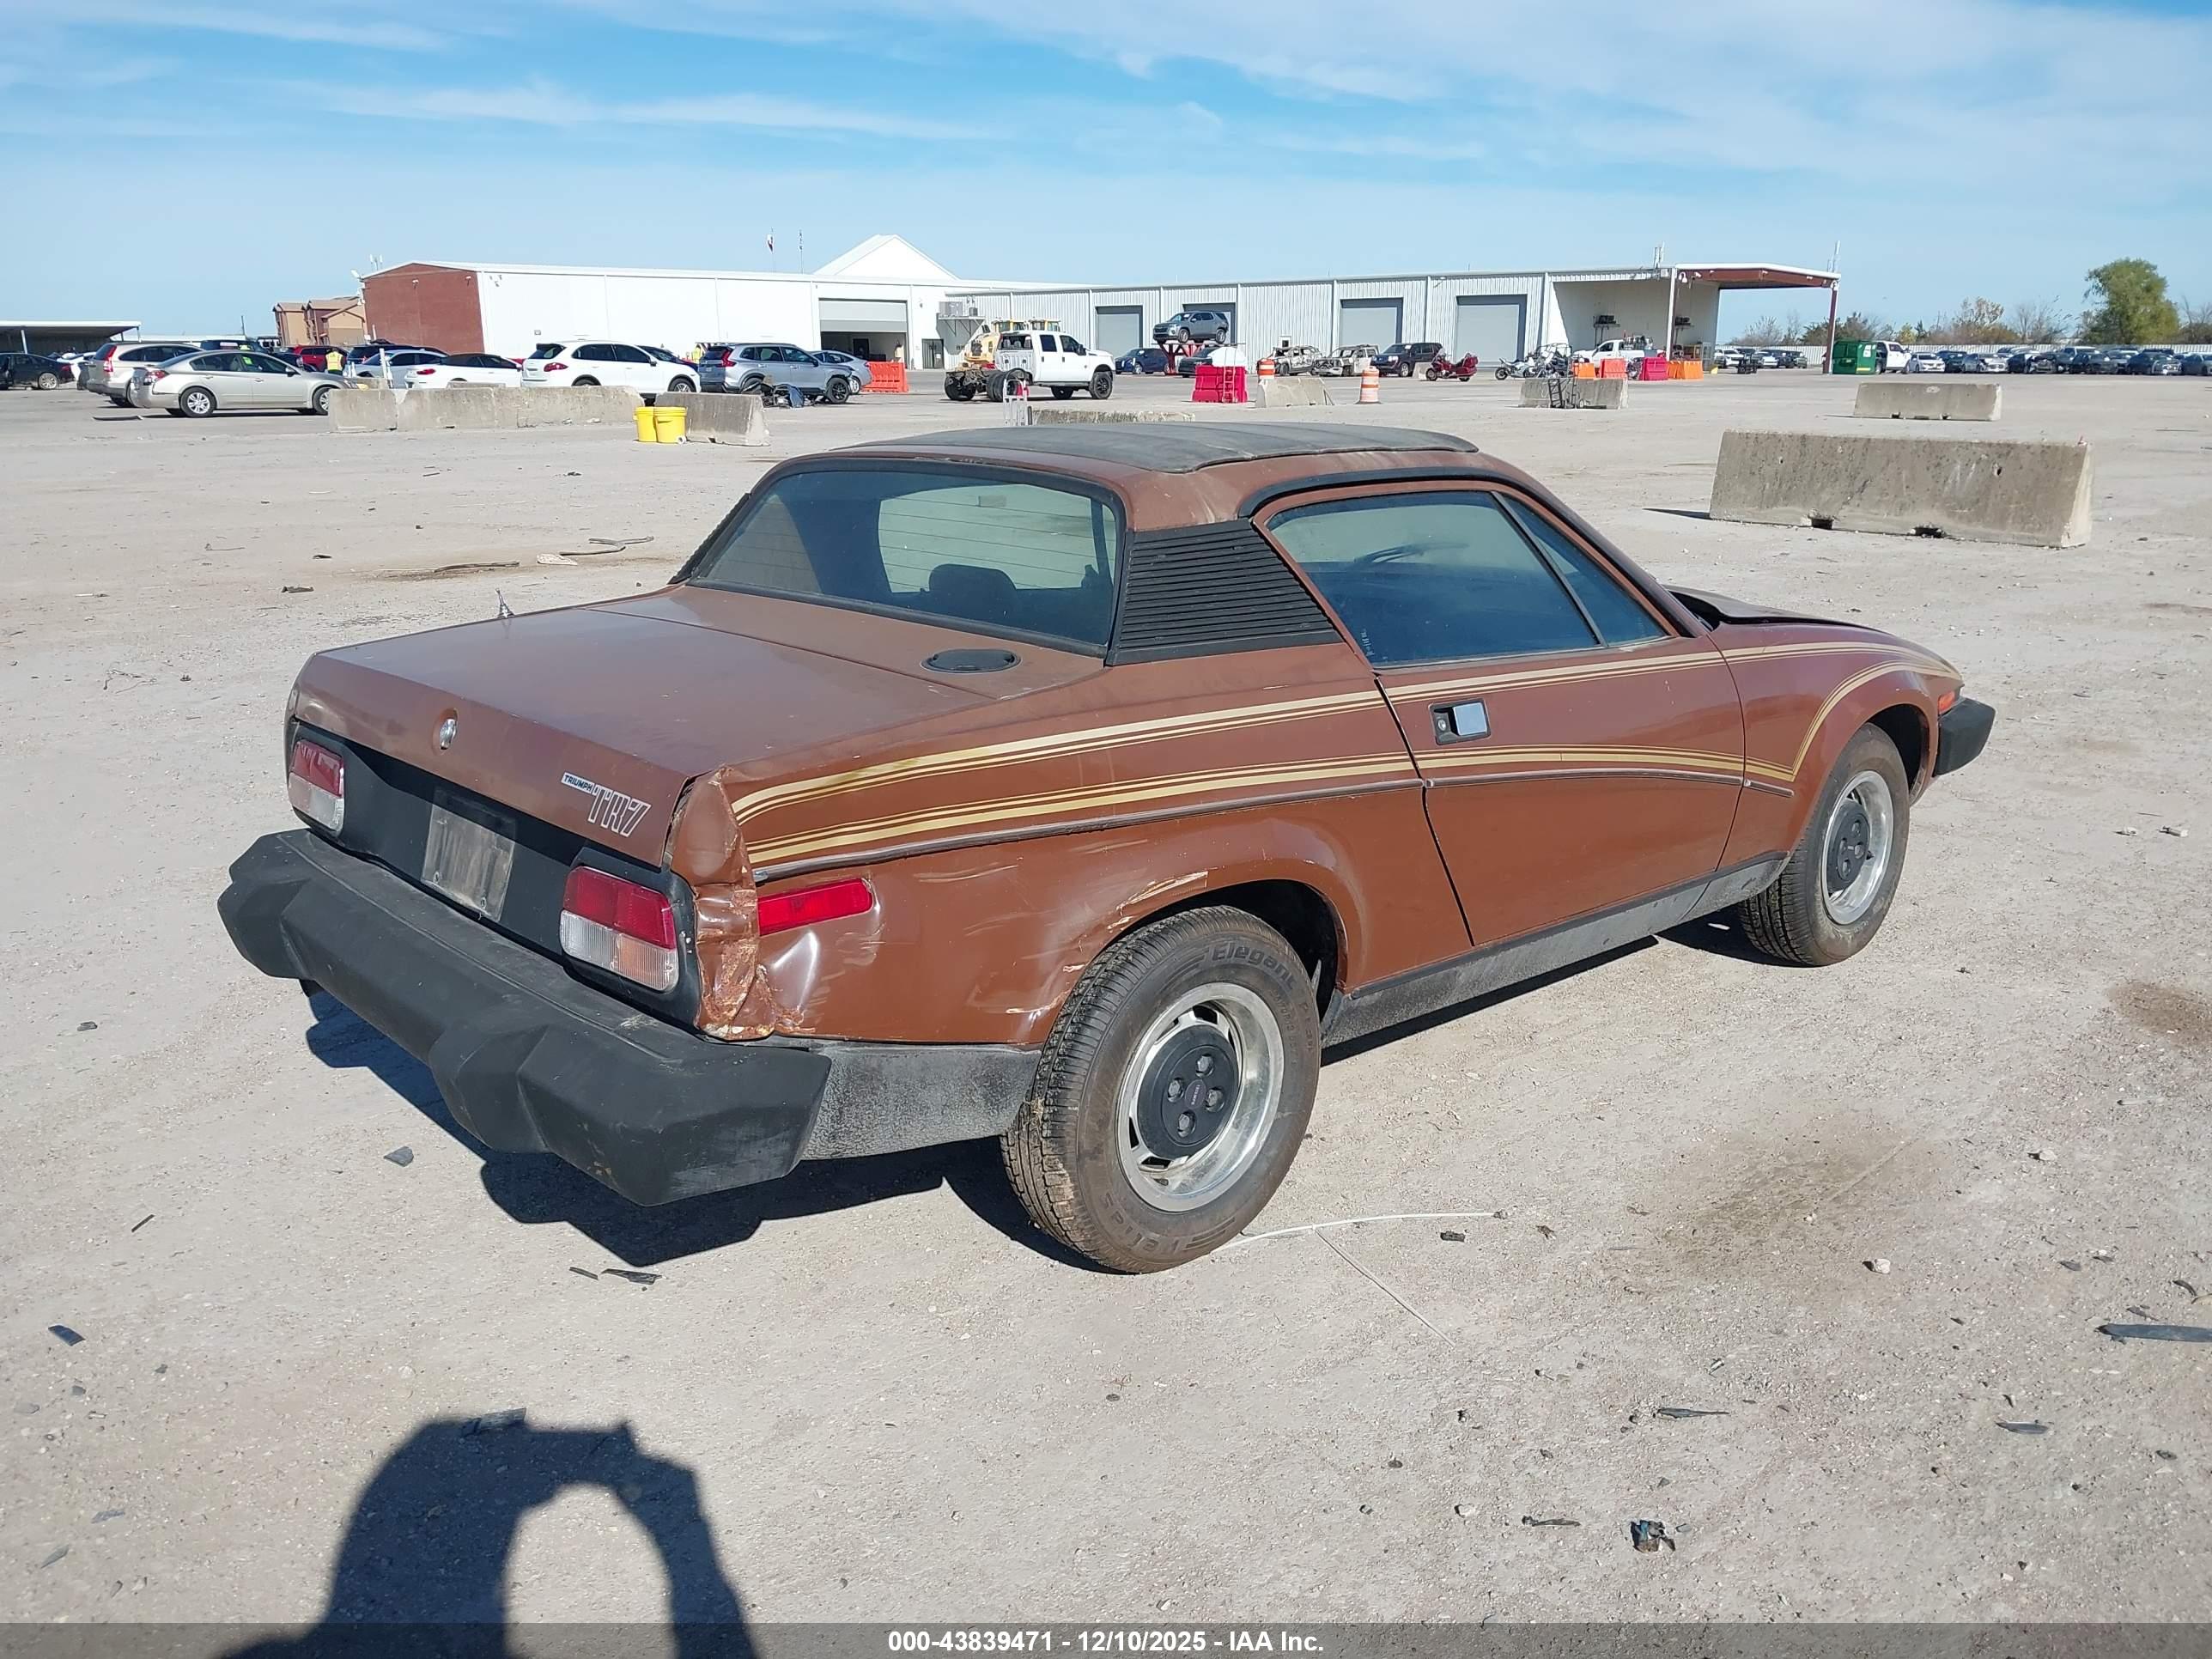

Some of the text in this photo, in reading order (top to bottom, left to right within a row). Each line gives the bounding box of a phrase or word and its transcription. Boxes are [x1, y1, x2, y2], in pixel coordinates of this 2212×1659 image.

[564, 774, 653, 838] TRIUMPH TR7
[1212, 943, 1297, 991] Elegant
